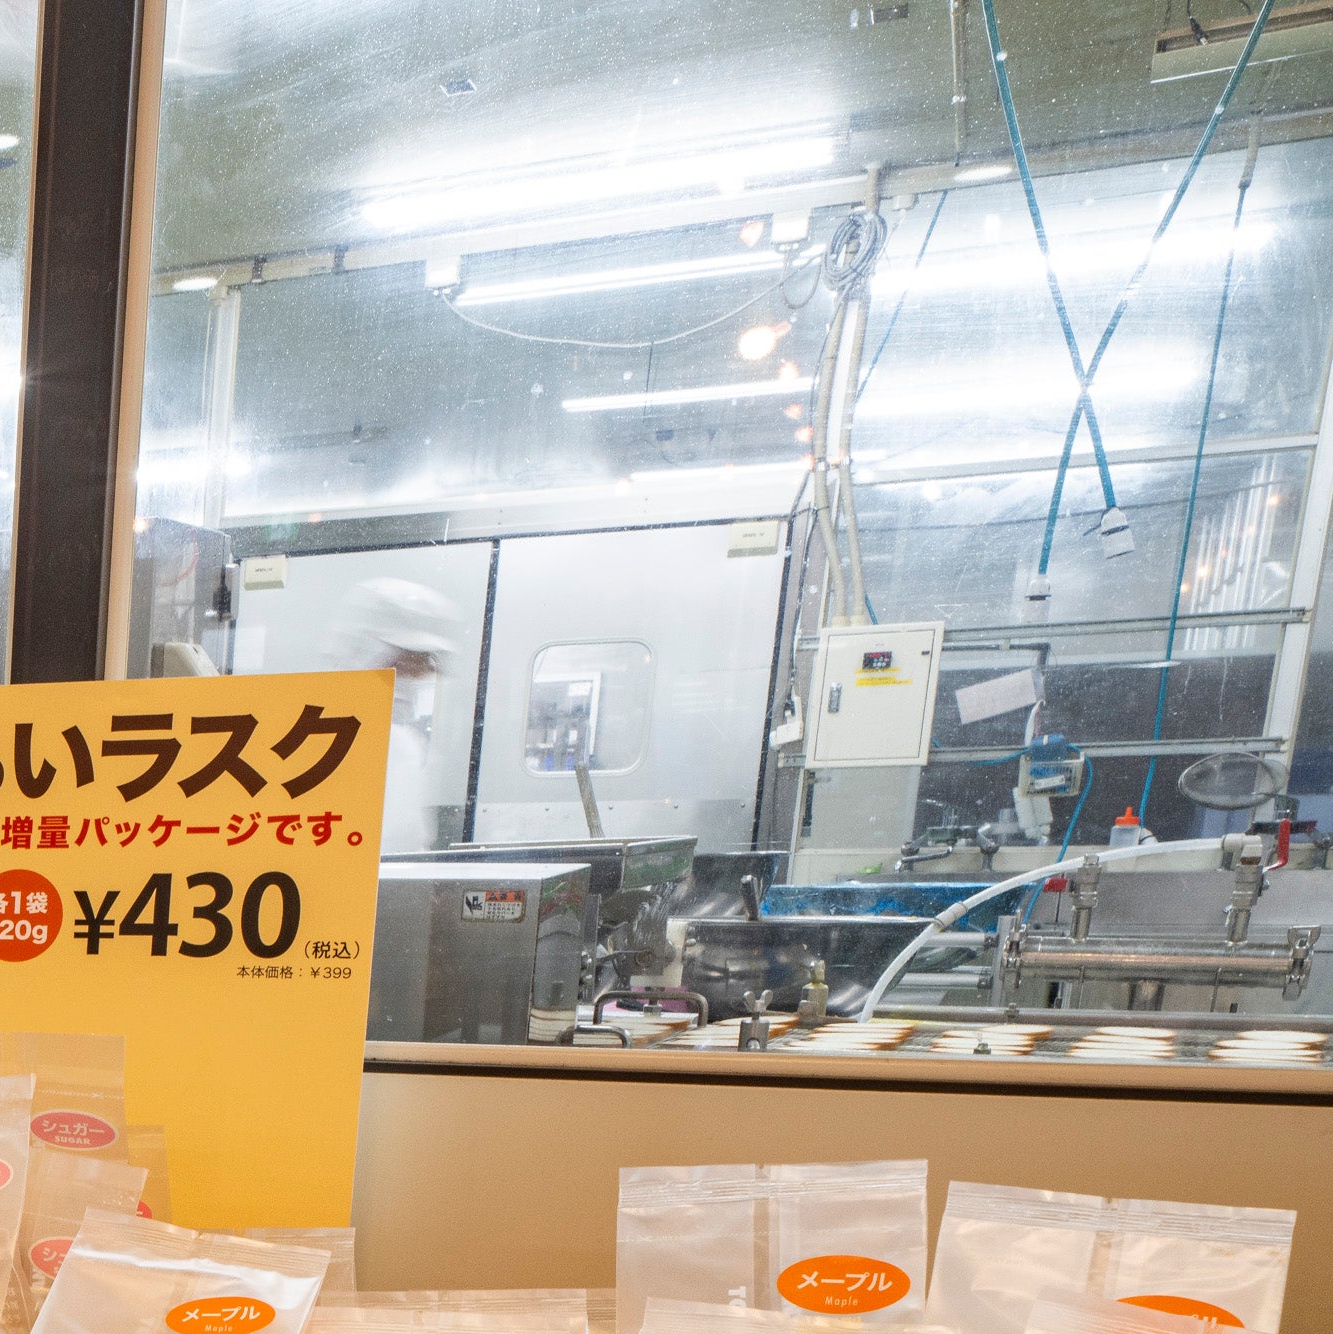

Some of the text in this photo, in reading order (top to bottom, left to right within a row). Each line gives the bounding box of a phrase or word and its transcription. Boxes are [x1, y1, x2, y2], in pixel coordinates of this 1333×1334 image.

[74, 870, 360, 961] ¥430 (税込)
[41, 1120, 105, 1138] シュガー
[797, 1270, 892, 1293] メープル
[183, 1307, 260, 1322] メープル
